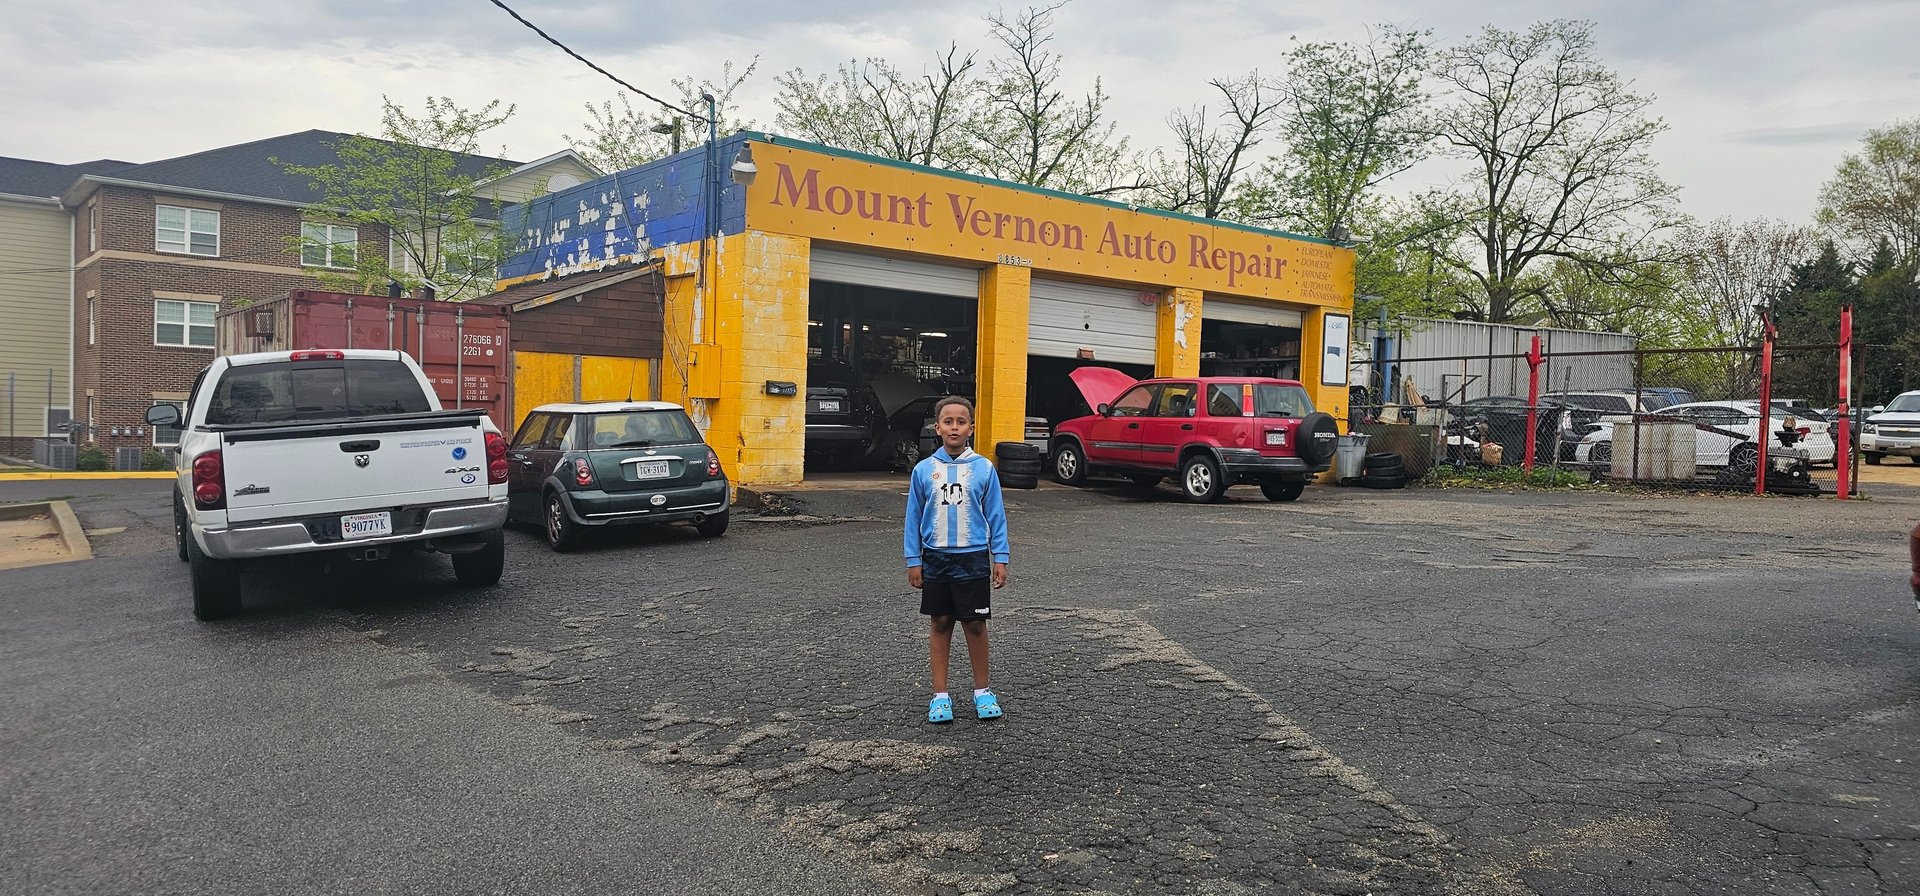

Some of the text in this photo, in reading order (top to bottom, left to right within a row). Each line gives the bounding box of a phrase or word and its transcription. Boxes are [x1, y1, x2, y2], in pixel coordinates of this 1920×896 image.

[768, 162, 1287, 288] Mount Vernon Auto Repair
[1301, 246, 1333, 258] EUROPEAN
[1300, 258, 1332, 270] DOMESTIC
[1300, 269, 1329, 280] JAPANESE
[1300, 281, 1336, 292] AUTOMATIC
[1299, 289, 1346, 302] TRANSMISSIONS
[463, 334, 492, 345] 276066
[463, 346, 481, 356] 22G1
[940, 483, 963, 506] 10
[351, 518, 386, 533] 9077VK
